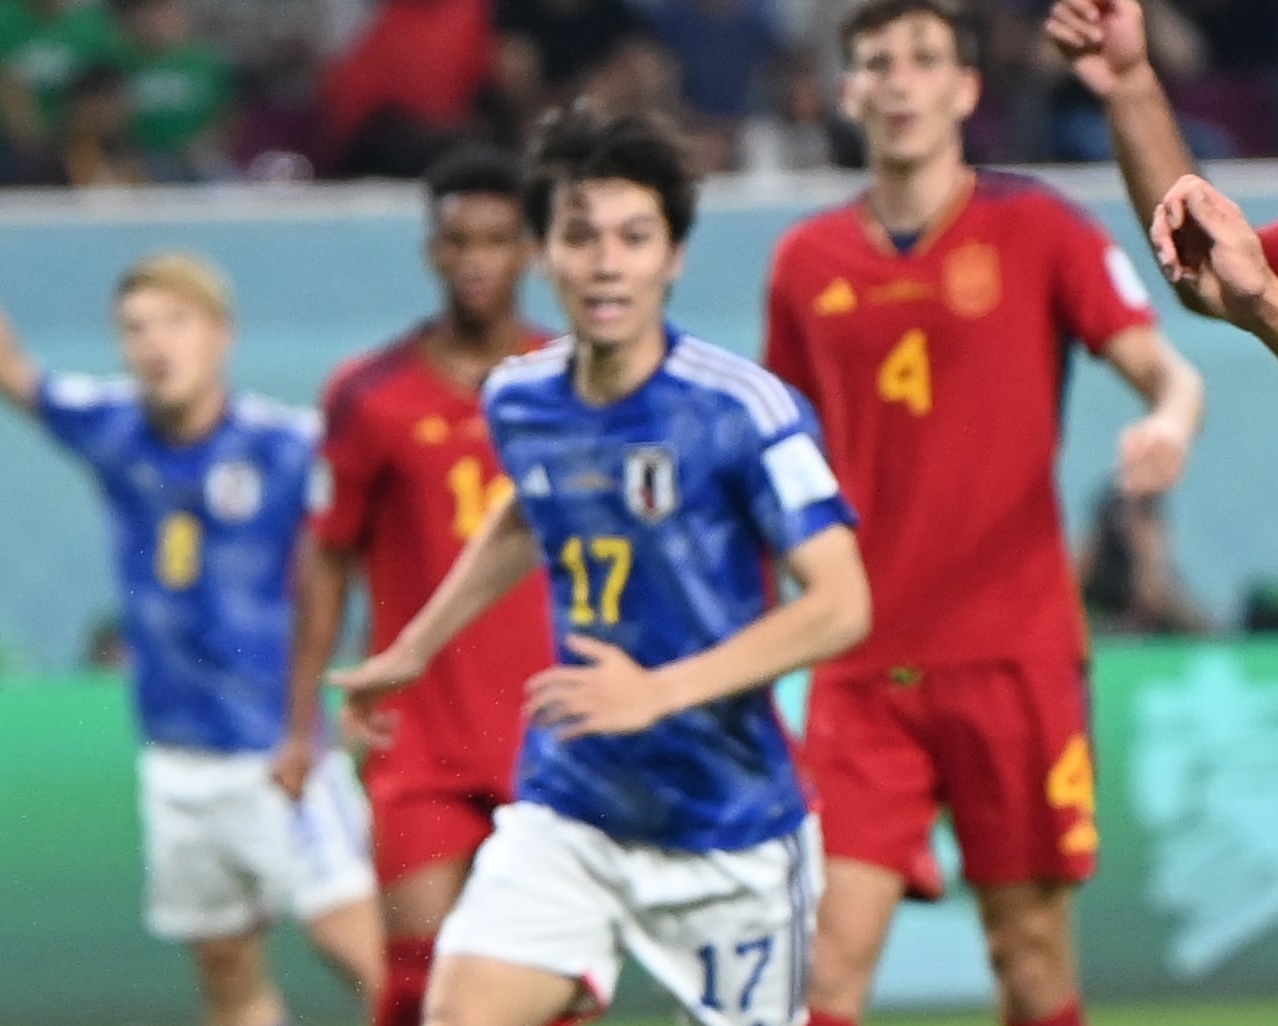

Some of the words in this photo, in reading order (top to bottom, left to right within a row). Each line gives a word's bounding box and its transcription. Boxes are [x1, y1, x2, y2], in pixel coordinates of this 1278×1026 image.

[877, 327, 933, 419] 4
[447, 454, 518, 542] 1
[560, 534, 634, 624] 17
[696, 936, 775, 1012] 17
